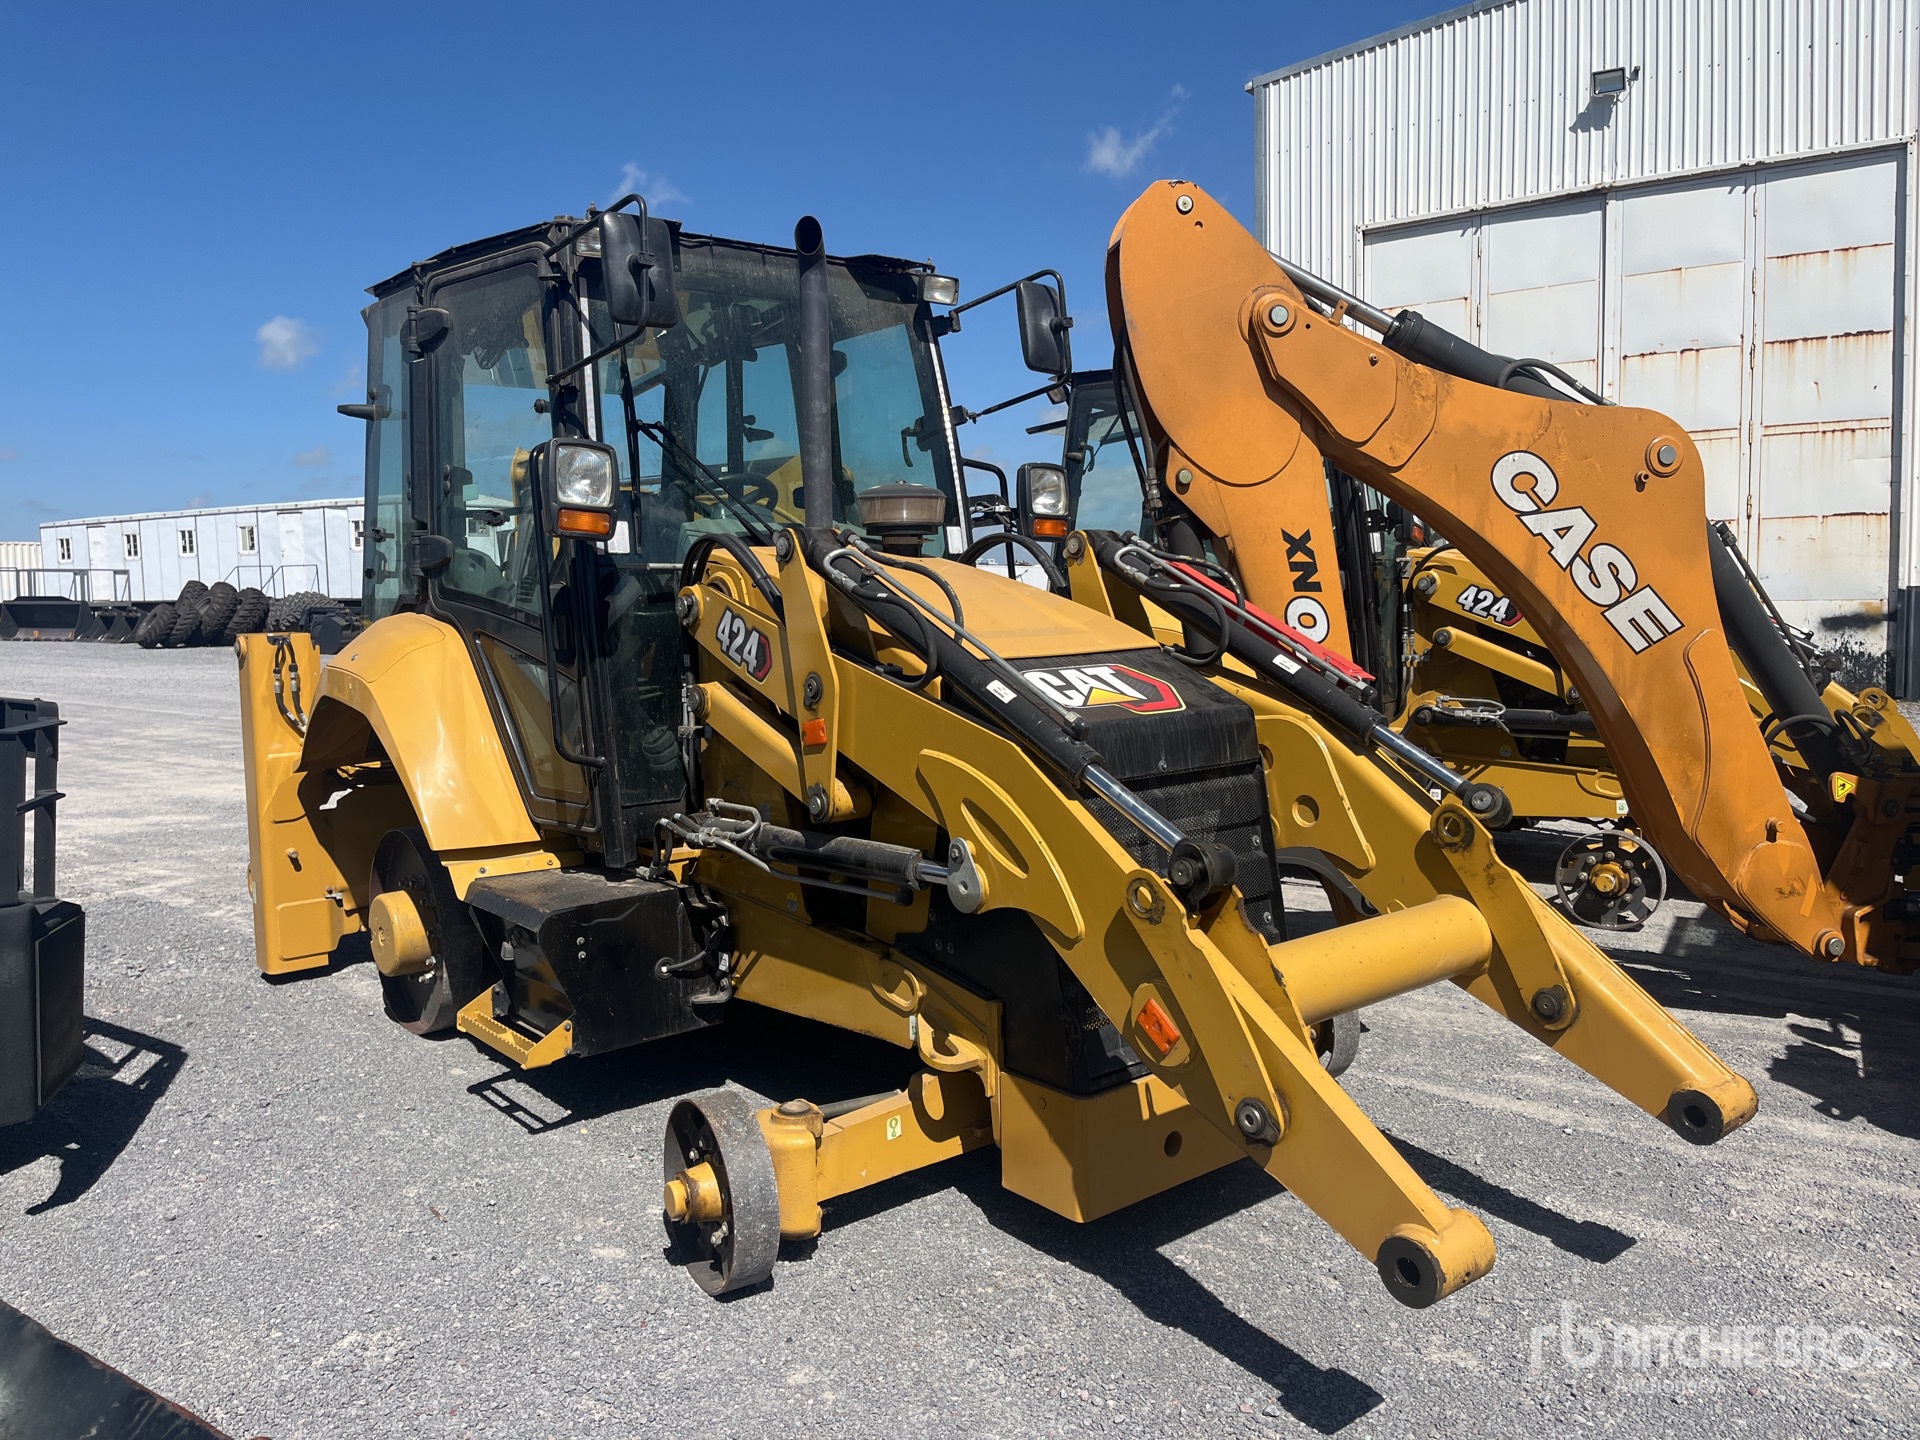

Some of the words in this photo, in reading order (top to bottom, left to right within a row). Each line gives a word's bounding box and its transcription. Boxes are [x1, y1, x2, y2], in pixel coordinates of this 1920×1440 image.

[1490, 450, 1685, 655] CASE
[1457, 585, 1510, 623] 424
[716, 606, 760, 675] 424
[1022, 665, 1148, 707] CAT
